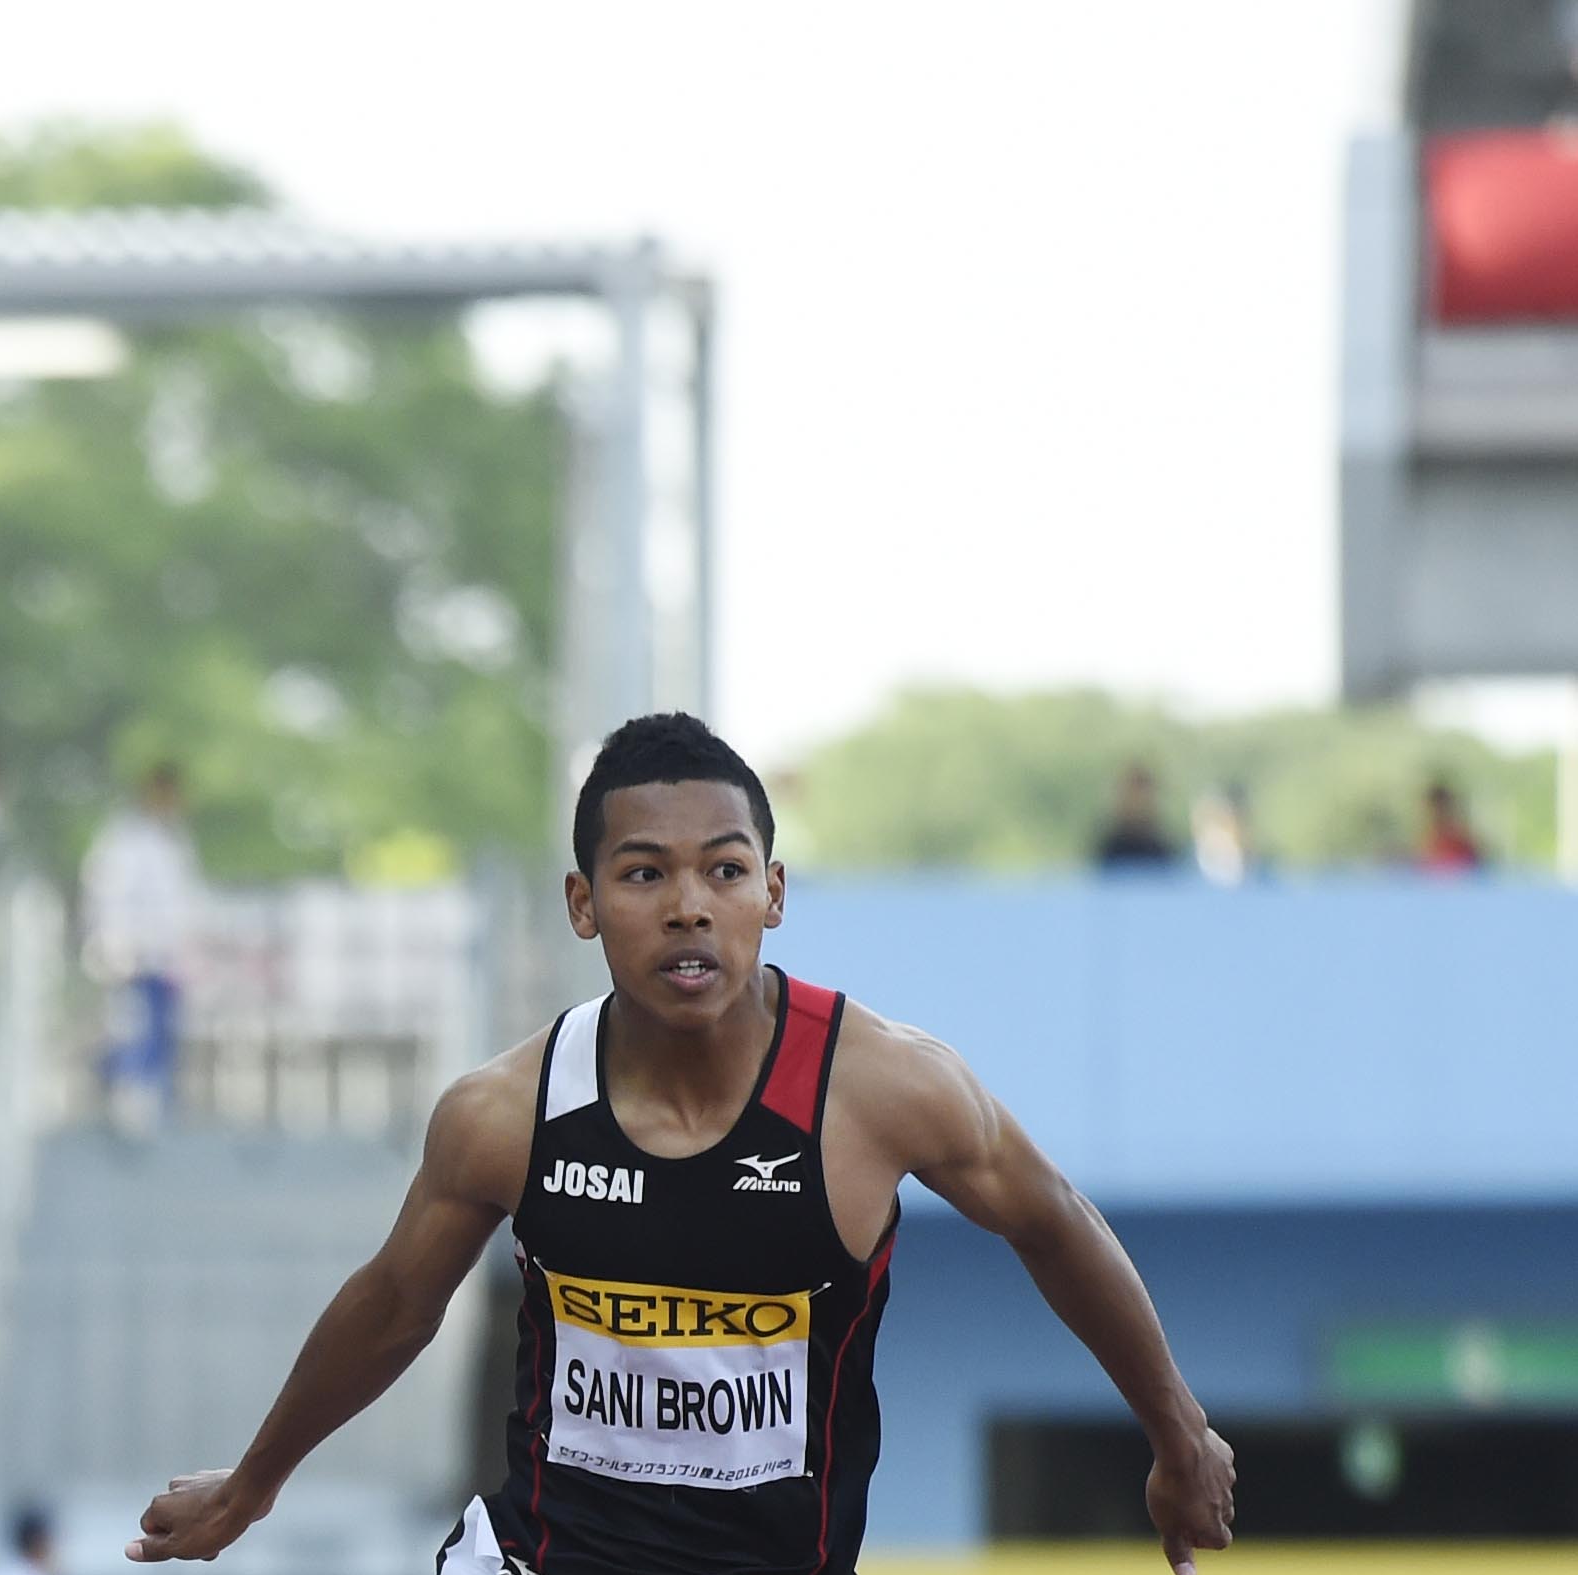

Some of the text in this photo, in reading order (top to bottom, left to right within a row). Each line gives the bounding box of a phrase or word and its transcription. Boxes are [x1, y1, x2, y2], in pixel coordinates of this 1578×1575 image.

[543, 1159, 644, 1204] JOSAI
[558, 1284, 797, 1338] SEIKO
[563, 1358, 792, 1435] SANI BROWN
